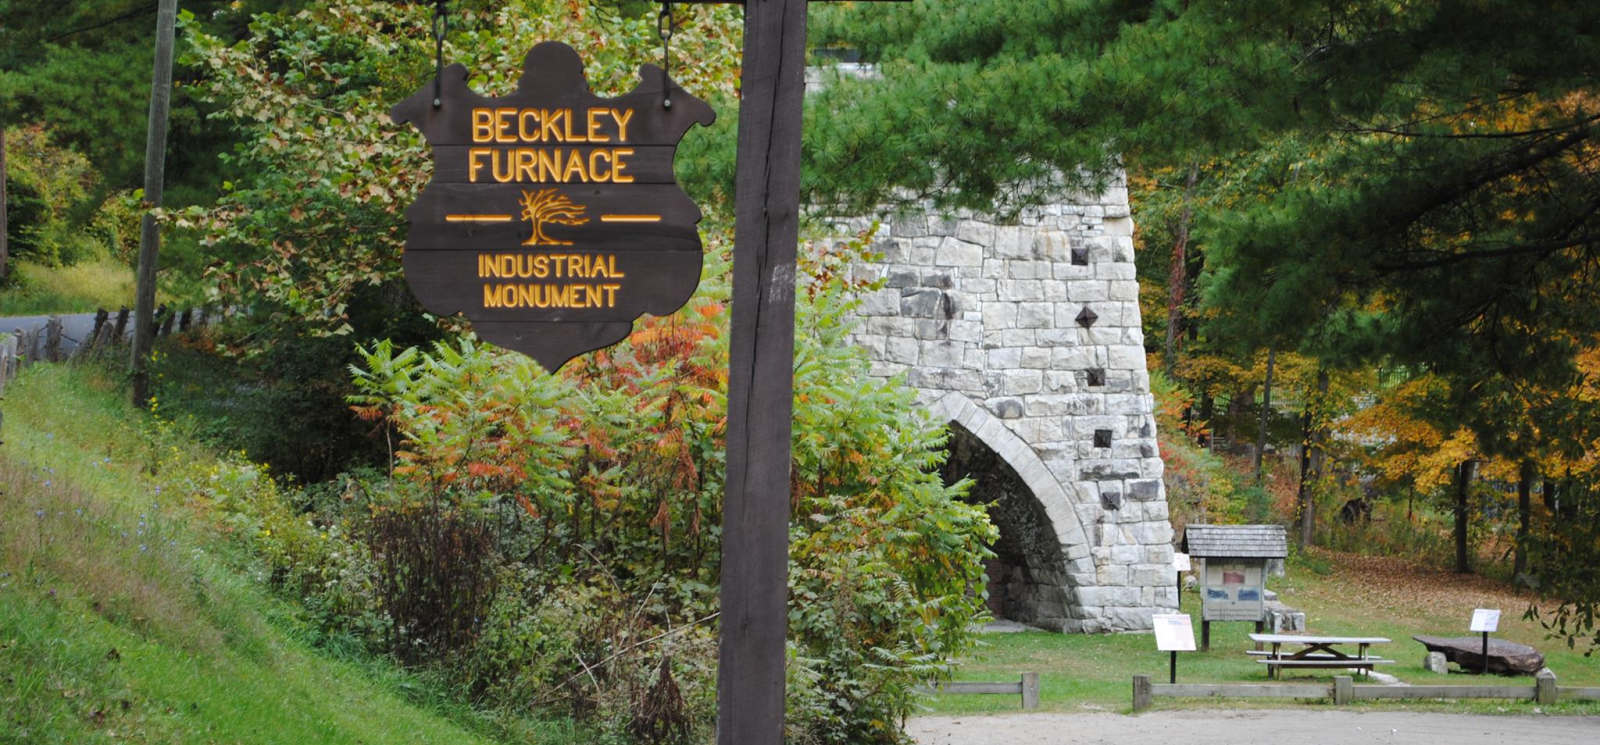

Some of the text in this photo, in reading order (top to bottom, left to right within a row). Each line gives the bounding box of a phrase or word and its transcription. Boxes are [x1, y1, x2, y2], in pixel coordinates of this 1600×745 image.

[471, 107, 634, 143] BECKLEY
[468, 147, 635, 184] FURNACE
[478, 253, 625, 279] INDUSTRIAL
[484, 283, 621, 309] MONUMENT
